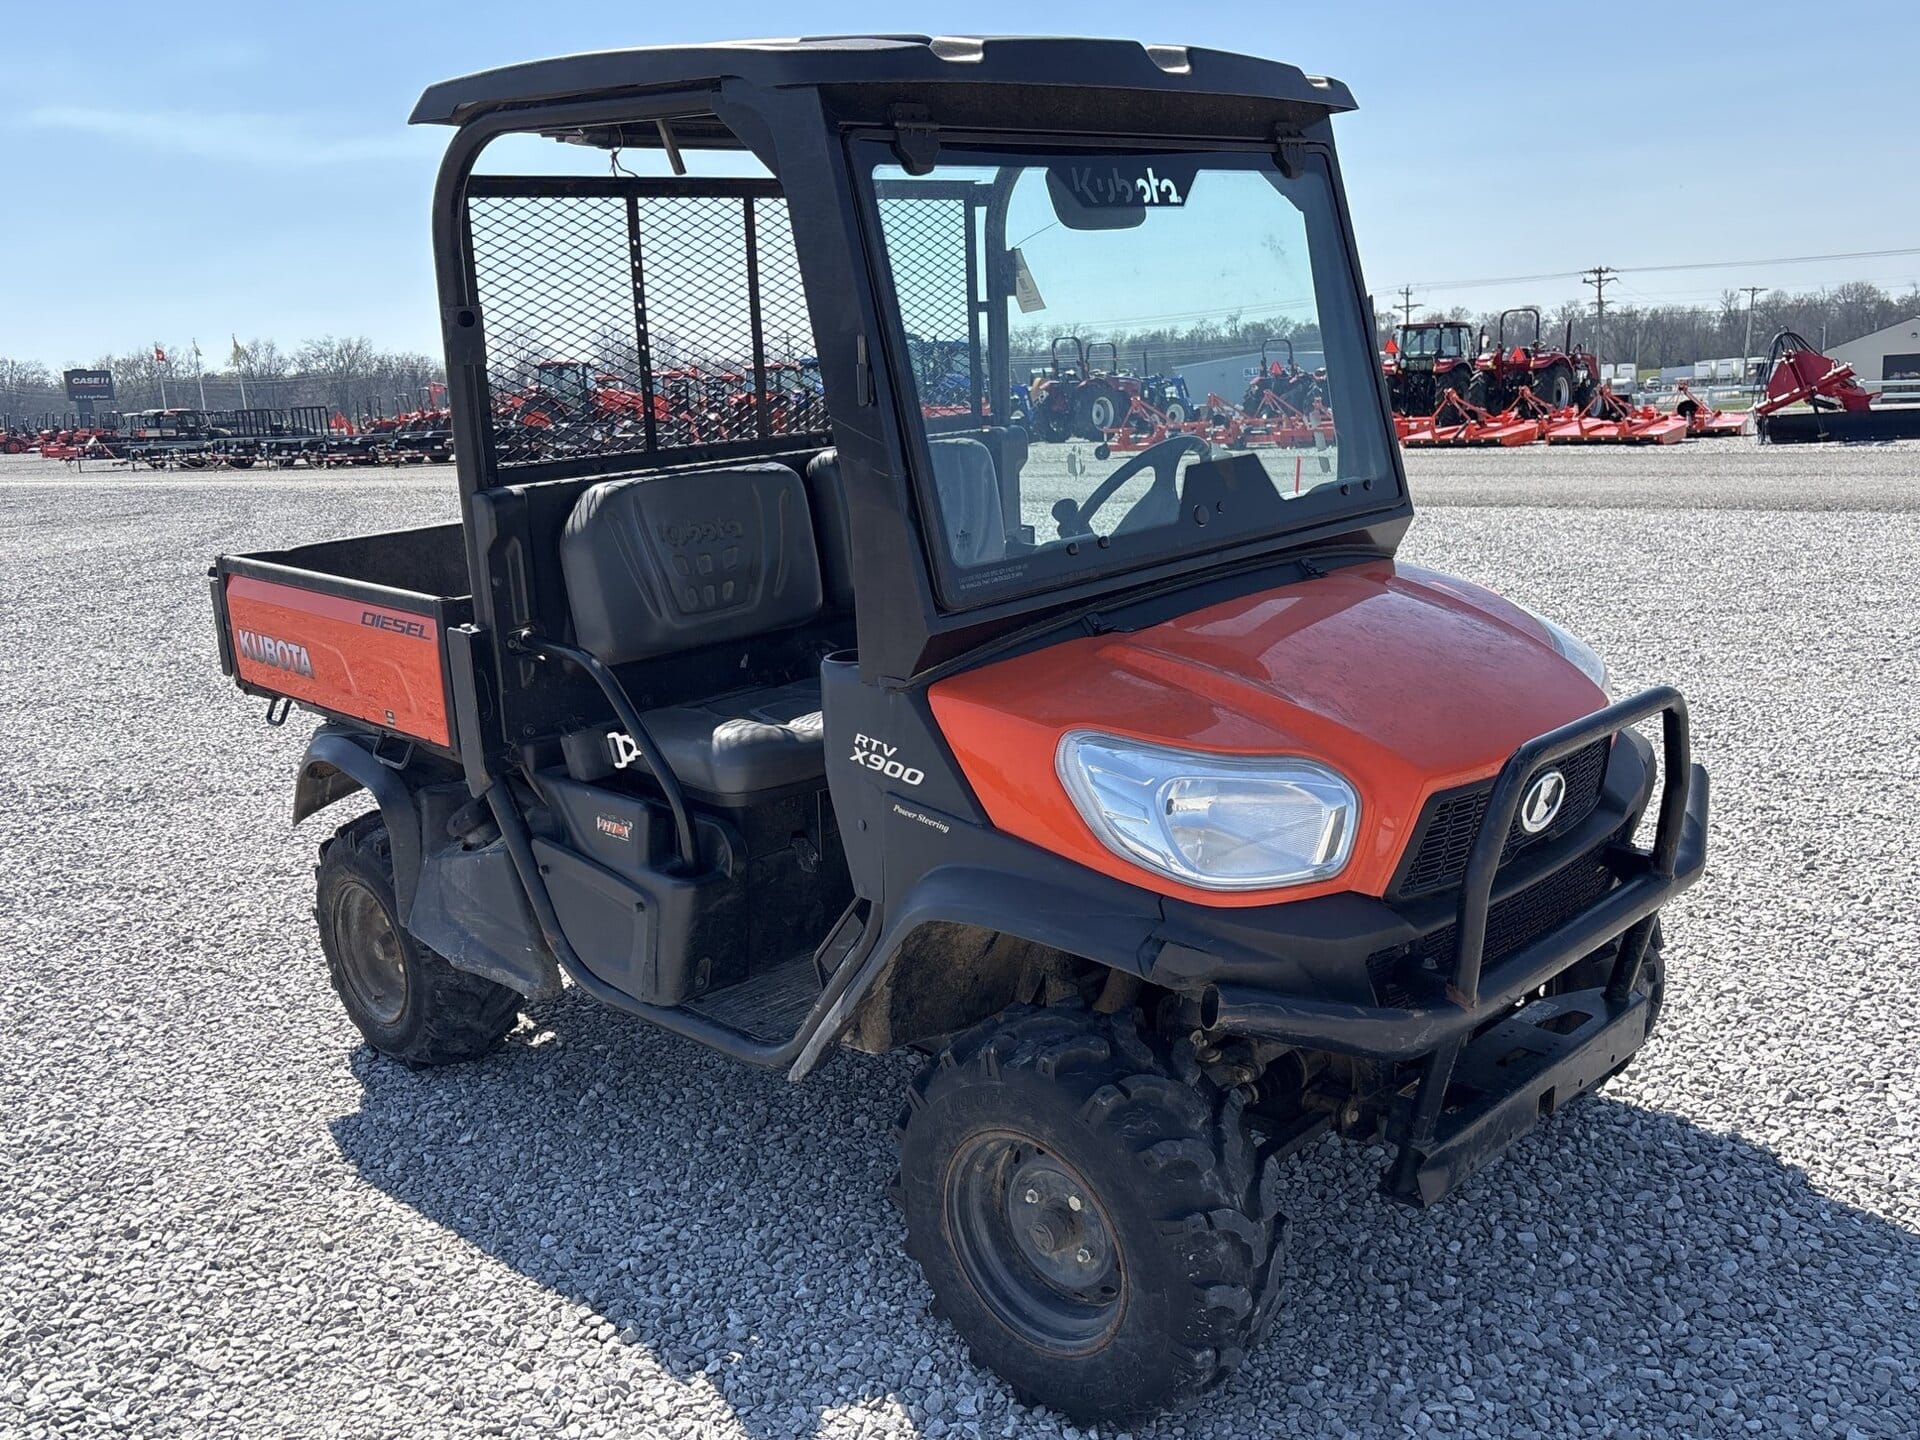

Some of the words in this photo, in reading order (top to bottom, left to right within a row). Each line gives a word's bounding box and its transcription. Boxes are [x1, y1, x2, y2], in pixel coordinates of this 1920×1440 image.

[1071, 167, 1181, 203] Kubota
[72, 377, 100, 385] CASE
[360, 611, 432, 641] DIESEL
[238, 628, 315, 680] KUBOTA
[854, 732, 898, 757] RTV
[849, 746, 925, 786] X900
[892, 804, 918, 820] Power
[916, 813, 951, 834] Steering
